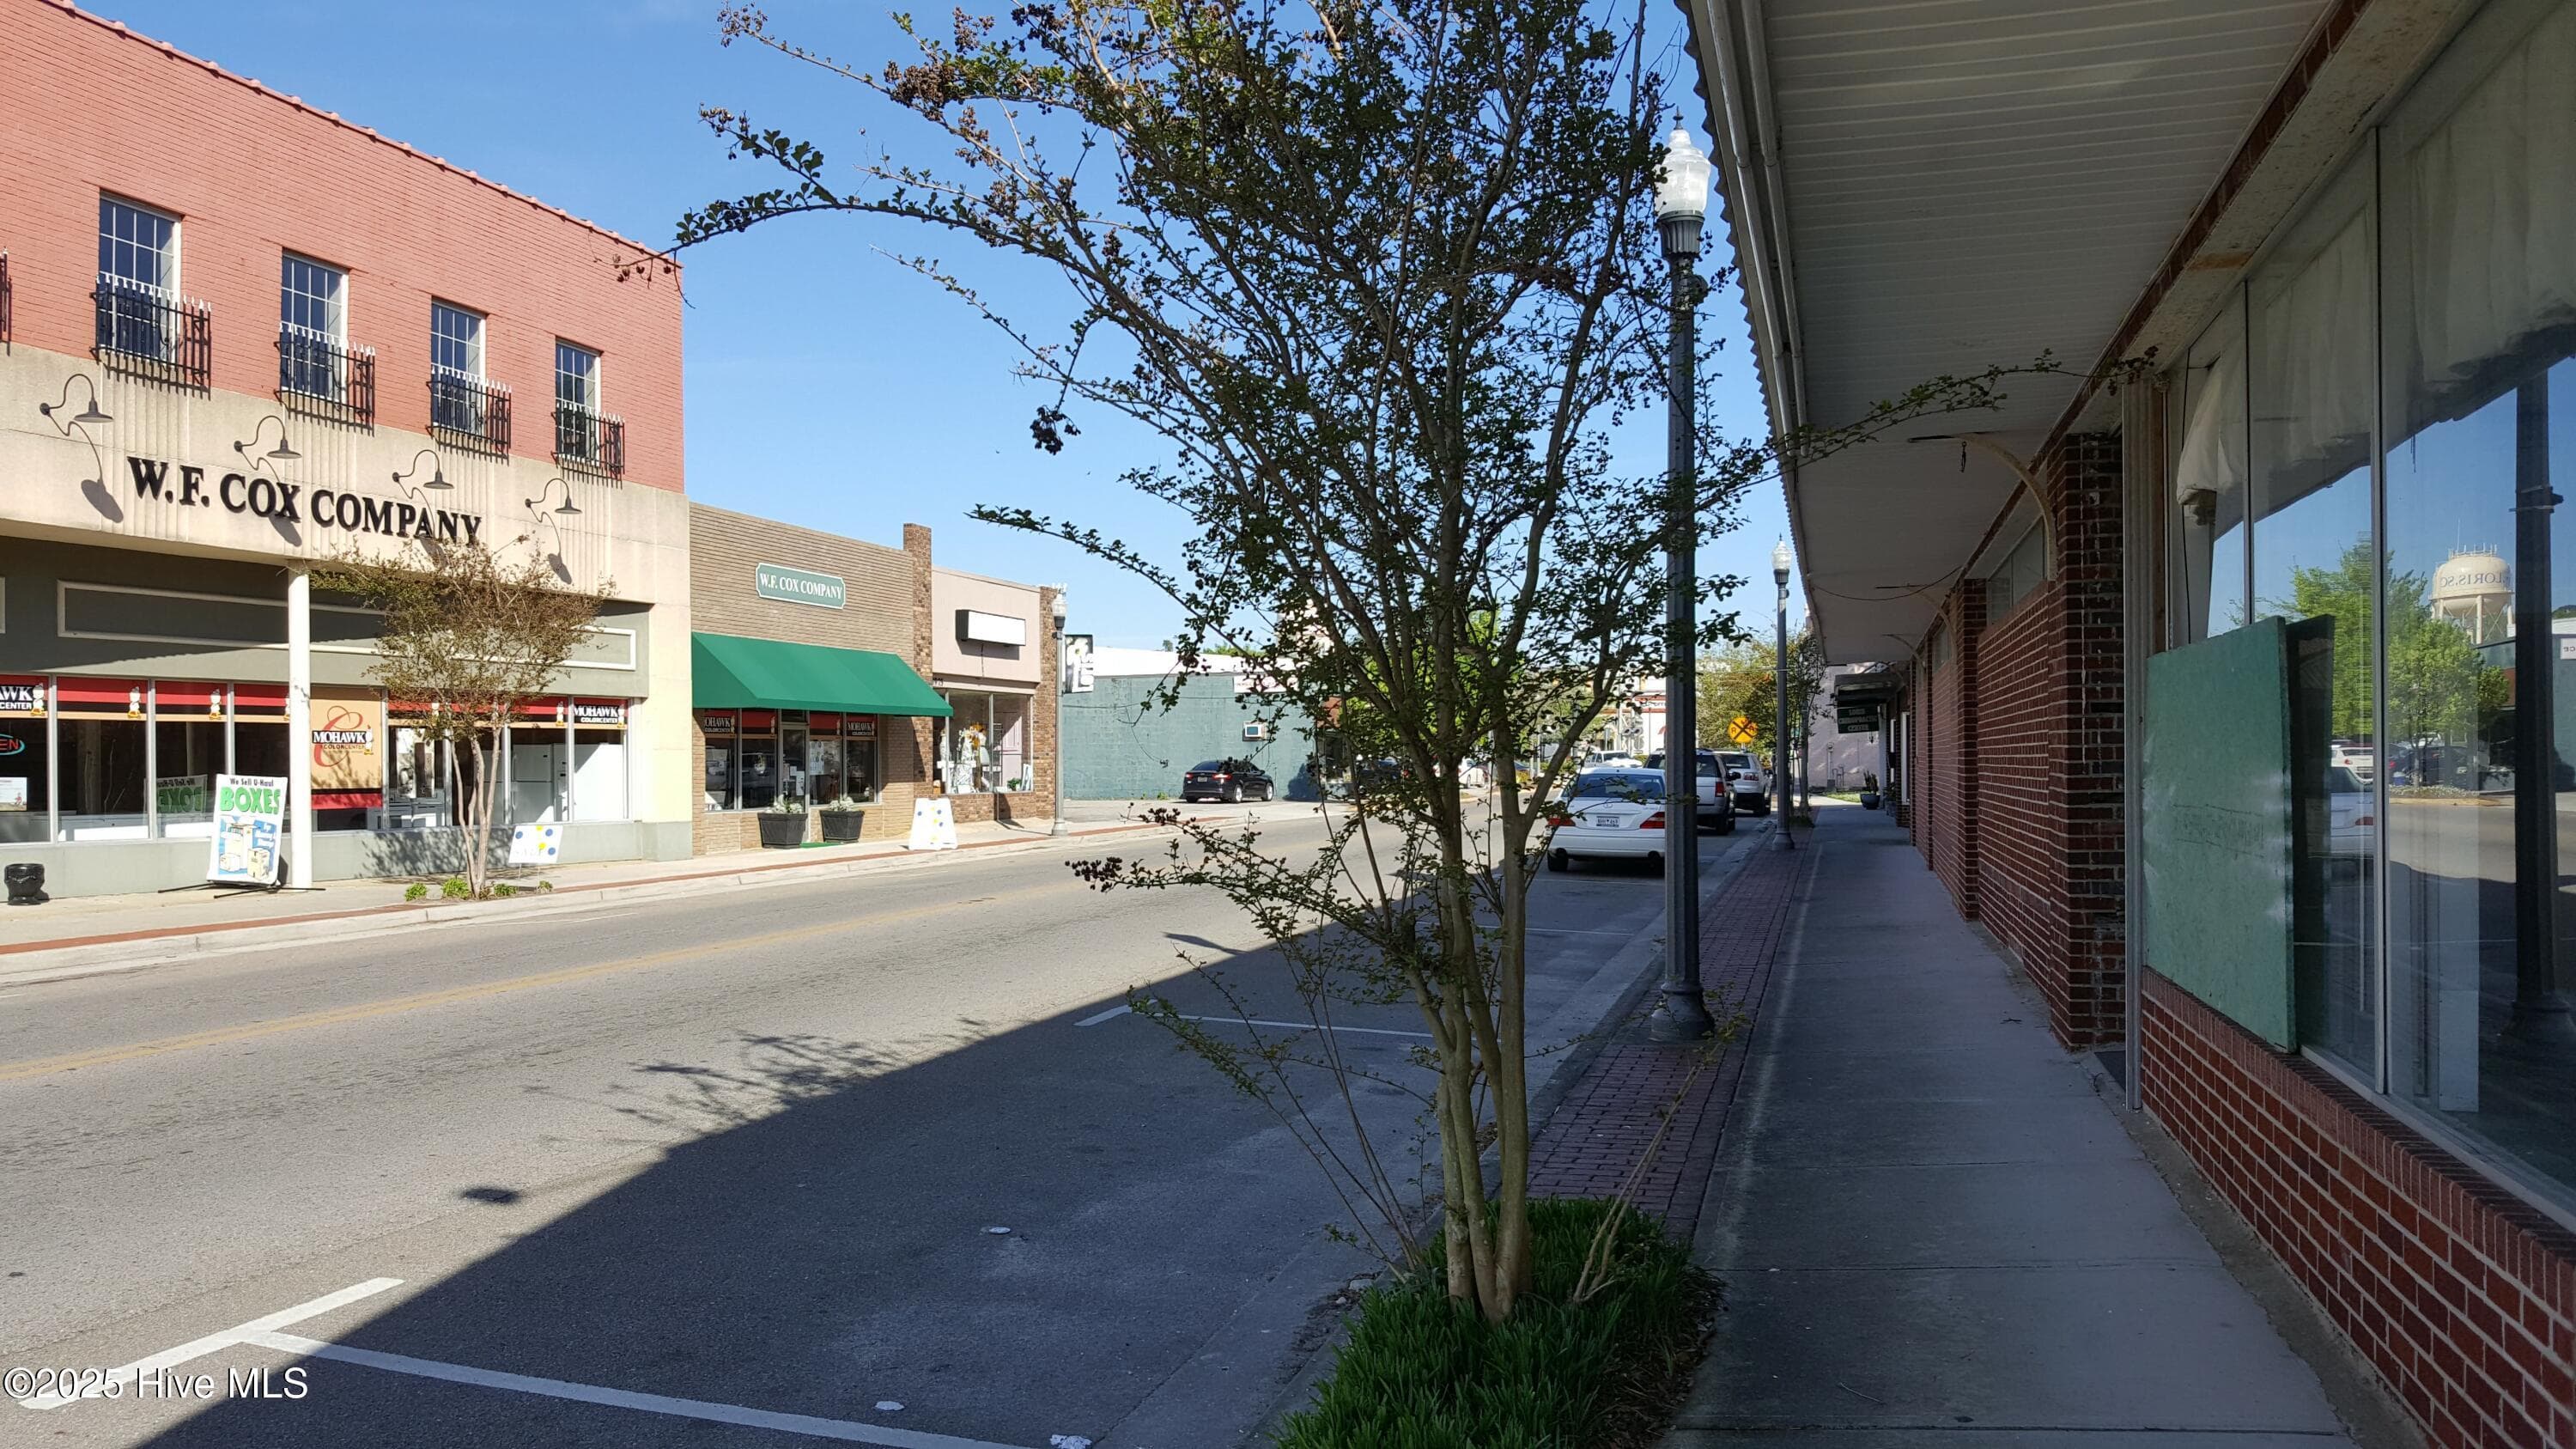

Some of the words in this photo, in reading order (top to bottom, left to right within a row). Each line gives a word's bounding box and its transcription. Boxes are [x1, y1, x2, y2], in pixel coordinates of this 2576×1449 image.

[127, 455, 210, 508] W.F.
[219, 472, 301, 523] COX
[310, 489, 483, 547] COMPANY
[759, 573, 778, 589] W.F.
[779, 576, 799, 593] COX
[800, 580, 842, 600] COMPANY
[574, 705, 618, 717] MOHAWK
[704, 716, 731, 728] OHAWK
[313, 732, 366, 743] MOHAWK
[219, 786, 282, 815] BOXES
